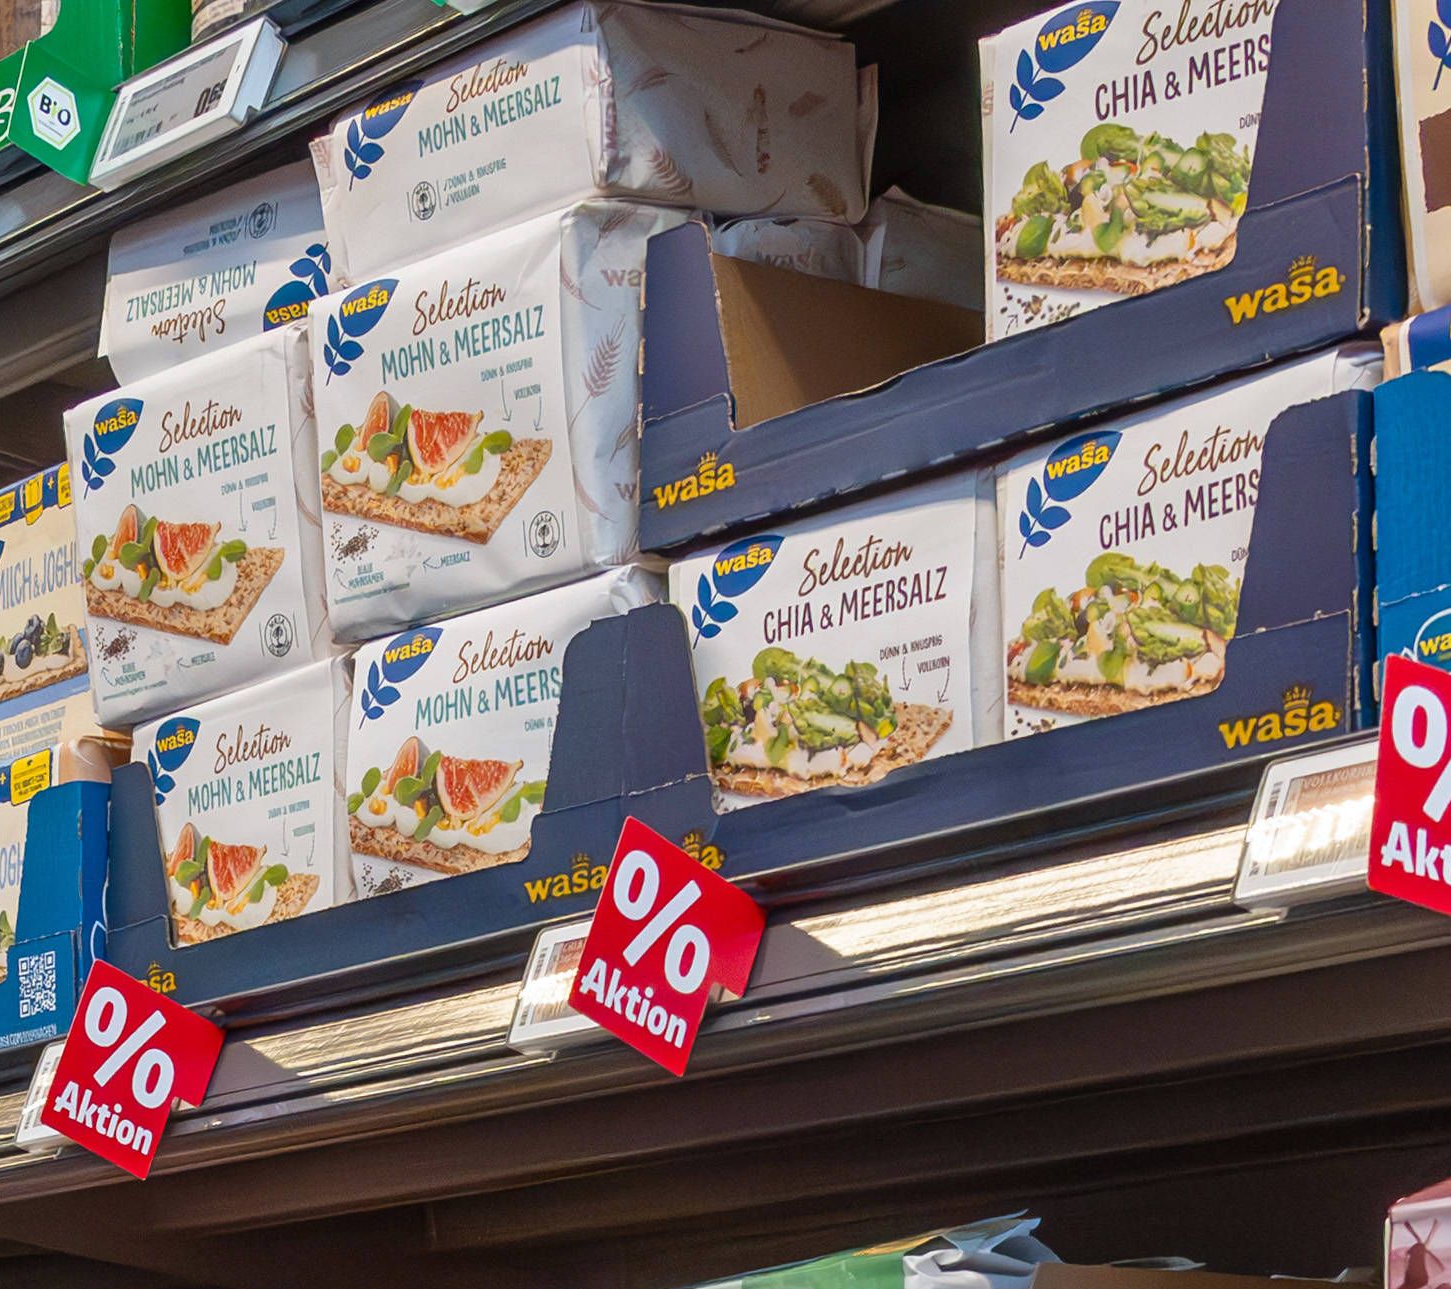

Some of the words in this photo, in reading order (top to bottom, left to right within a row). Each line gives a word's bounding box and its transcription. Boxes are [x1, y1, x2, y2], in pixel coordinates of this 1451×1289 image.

[446, 56, 529, 113] Selection
[1095, 66, 1157, 122] CHIA
[419, 116, 466, 158] MOHN
[469, 117, 482, 137] &
[483, 76, 562, 133] MEERSALZ
[412, 278, 507, 336] Selection
[1226, 266, 1345, 325] wasa
[382, 338, 437, 384] MOHN
[454, 306, 545, 362] MEERSALZ
[130, 460, 177, 499] MOHN
[763, 602, 813, 645] CHIA
[611, 849, 711, 994] %
[579, 957, 687, 1049] Aktion
